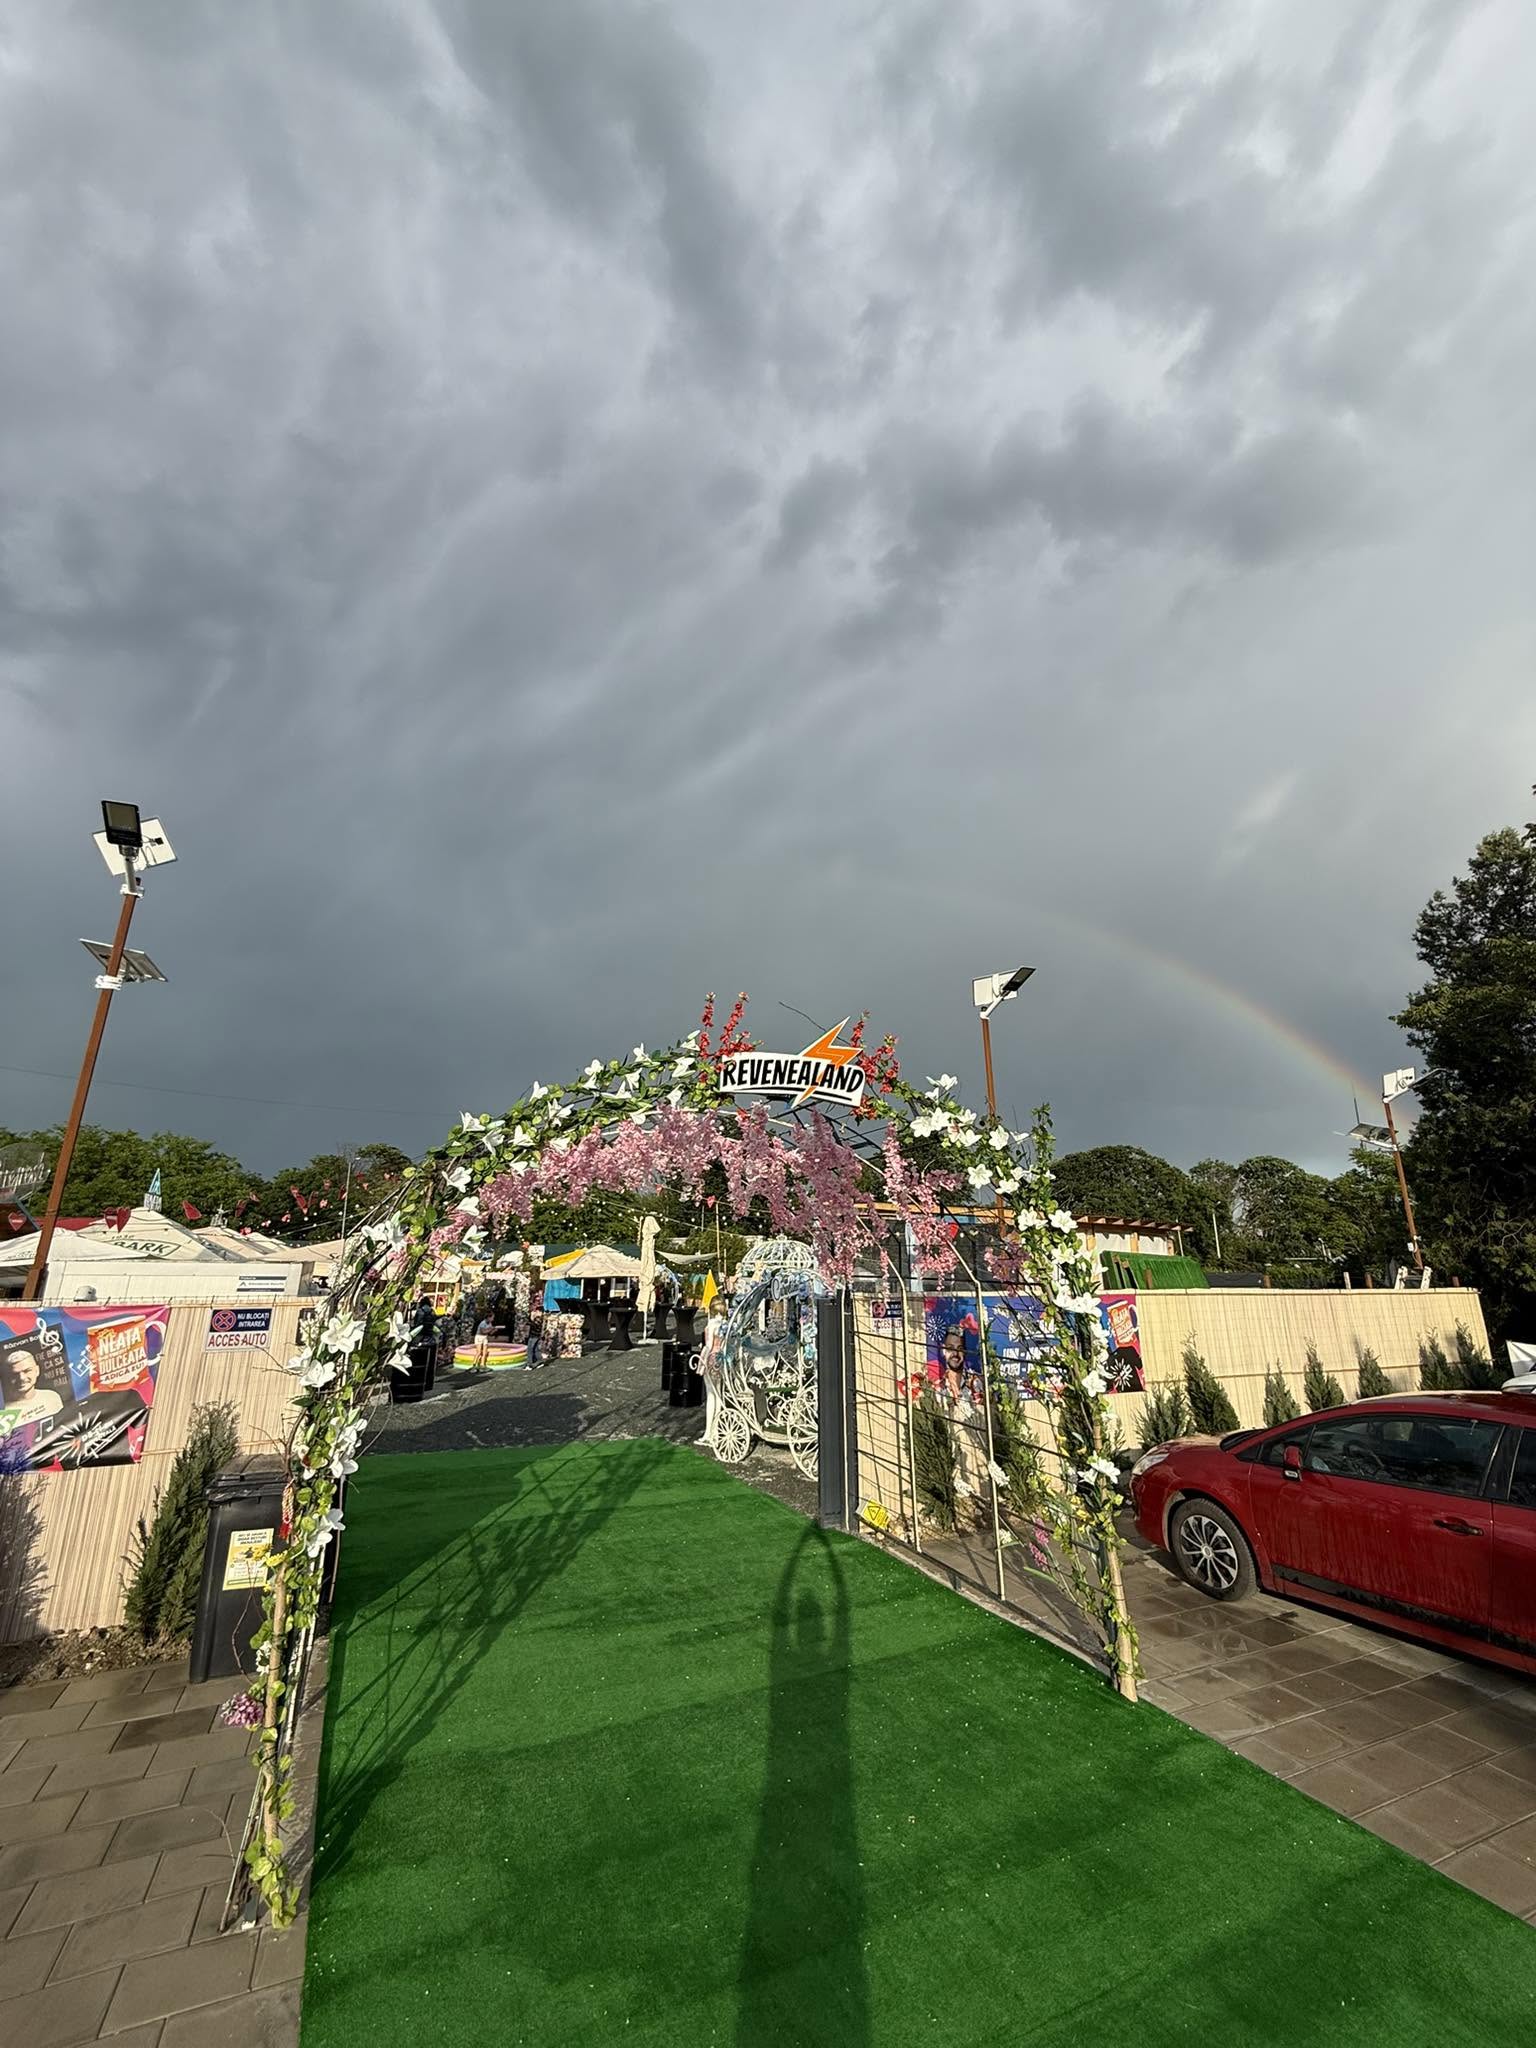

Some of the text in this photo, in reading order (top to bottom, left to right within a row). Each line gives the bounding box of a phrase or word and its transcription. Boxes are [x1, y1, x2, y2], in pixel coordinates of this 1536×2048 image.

[722, 1059, 864, 1093] REVENEALAND
[238, 1320, 266, 1328] INTRAREA
[208, 1333, 267, 1347] ACCES AUTO
